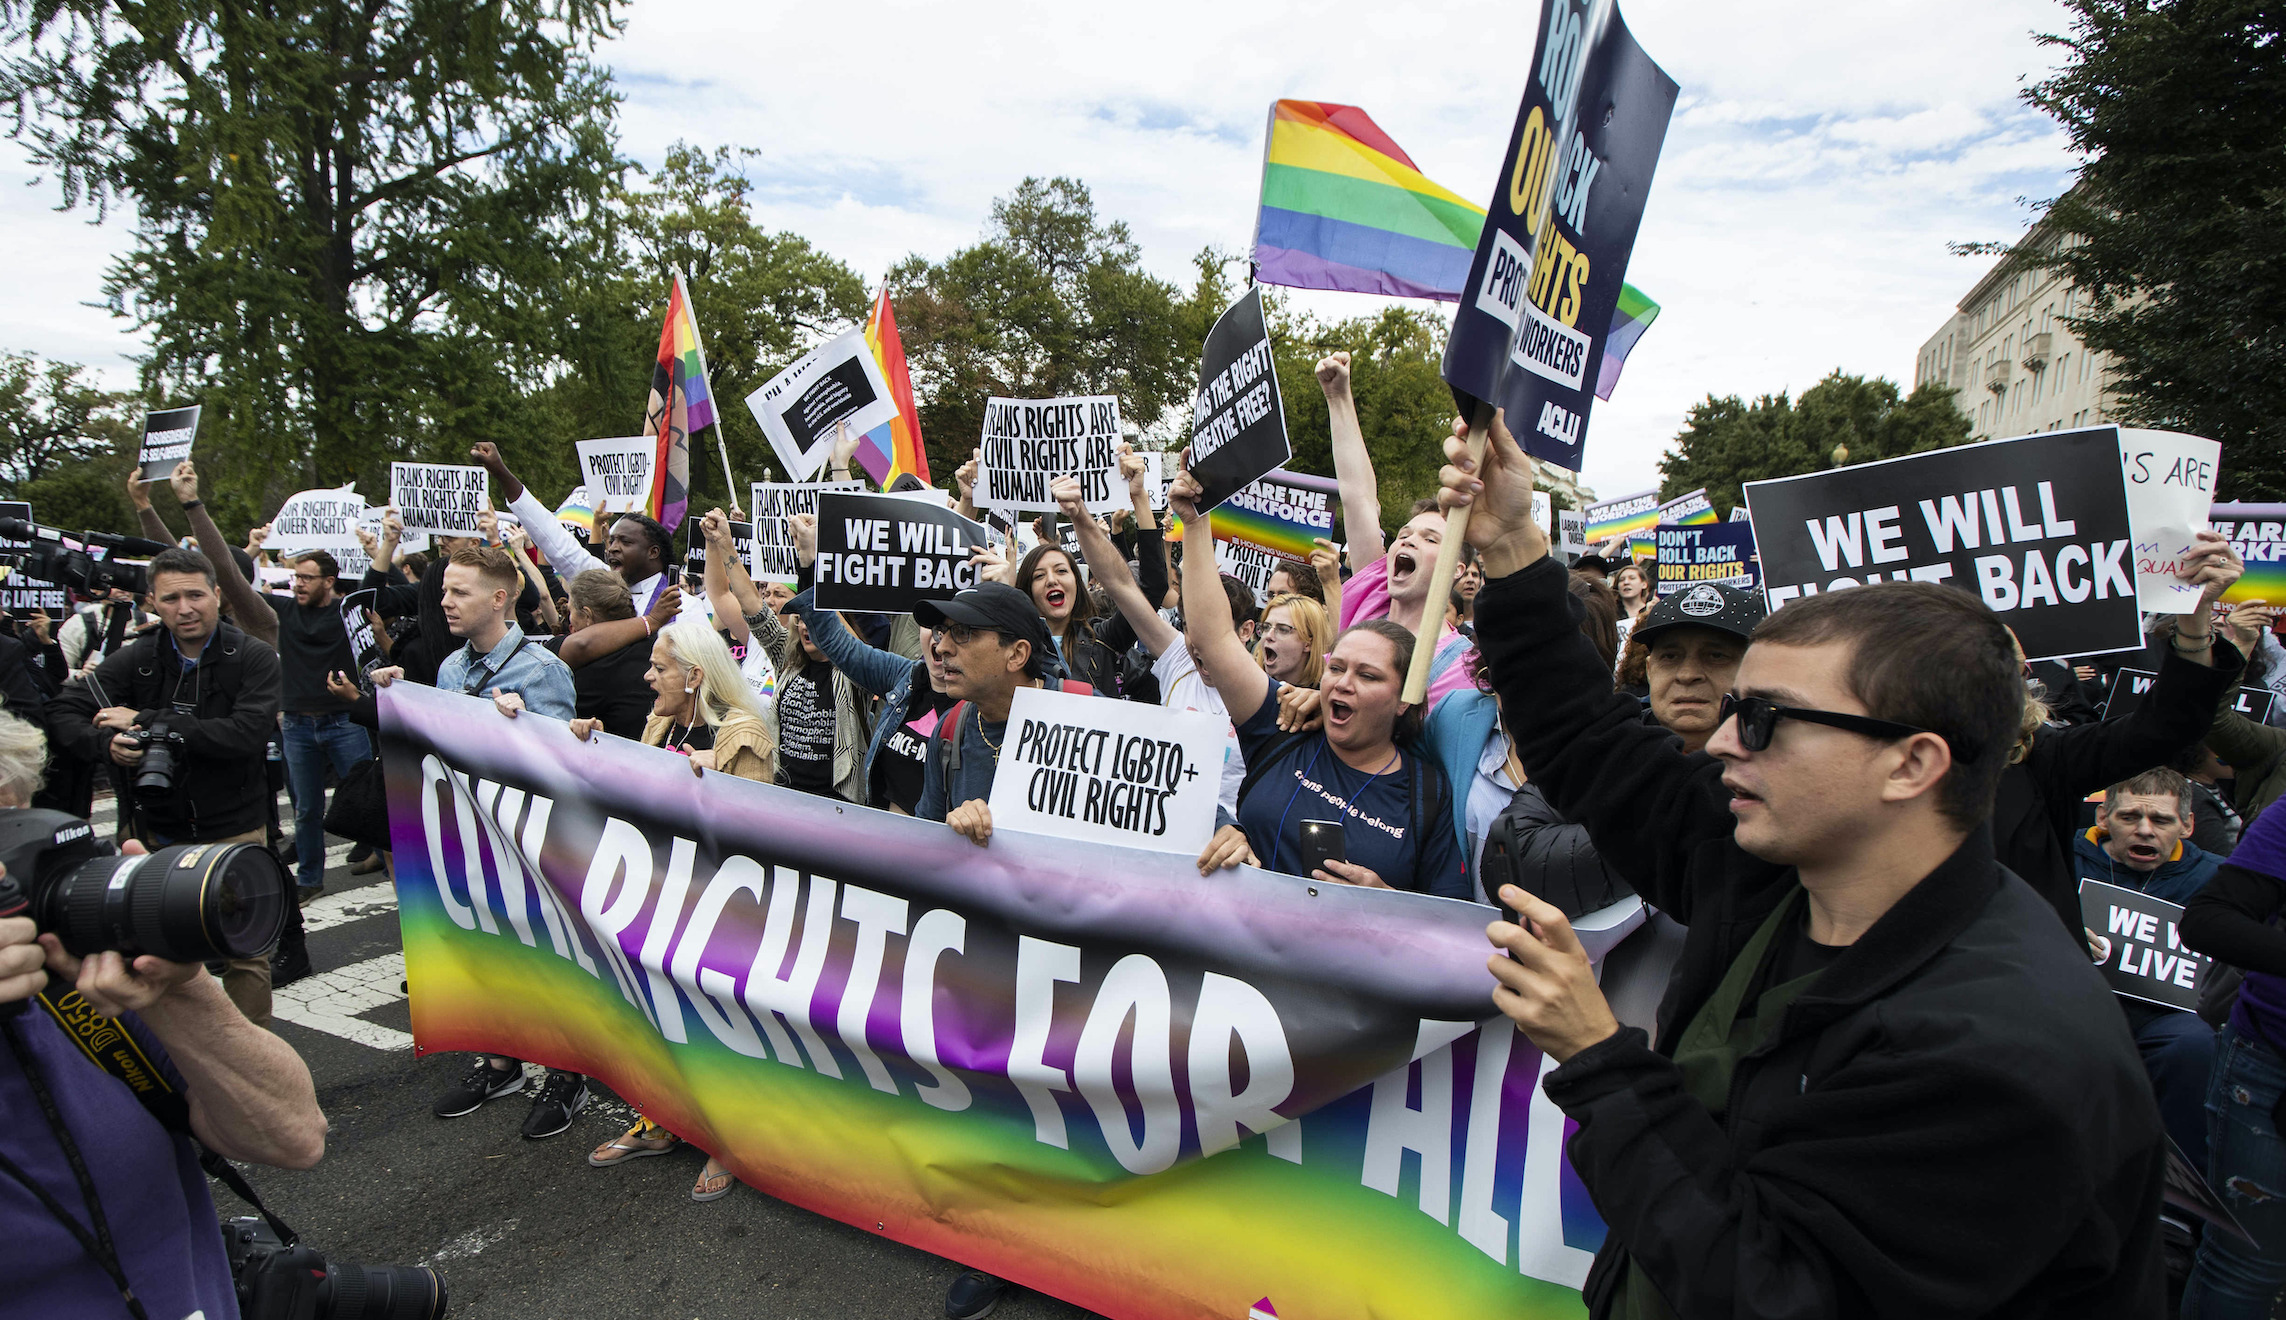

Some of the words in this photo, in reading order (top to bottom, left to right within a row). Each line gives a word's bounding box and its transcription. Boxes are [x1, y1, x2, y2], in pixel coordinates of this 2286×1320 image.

[1510, 105, 1559, 238] OU
[1519, 313, 1584, 378] WORKERS
[1210, 369, 1233, 410] THE
[1230, 338, 1269, 394] RIGHT
[985, 403, 1021, 438] TRANS
[1025, 403, 1085, 438] RIGHTS
[1090, 402, 1118, 435] ARE
[1193, 406, 1239, 463] BREATHE
[1235, 380, 1273, 431] FREE?
[1536, 401, 1581, 446] ACLU
[589, 453, 625, 475] PROTECT
[984, 436, 1016, 470] CIVIL
[1019, 438, 1079, 471] RIGHTS
[1084, 435, 1115, 469] ARE
[395, 467, 423, 488] TRANS
[426, 469, 460, 490] RIGHTS
[464, 471, 484, 491] ARE
[604, 475, 621, 496] CIVIL
[622, 474, 645, 495] RIGHTS
[989, 469, 1046, 502] HUMAN
[2164, 457, 2211, 491] ARE
[302, 502, 337, 517] RIGHTS
[341, 503, 360, 519] ARE
[398, 487, 419, 508] CIVIL
[422, 489, 457, 510] RIGHTS
[461, 491, 479, 512] ARE
[755, 489, 782, 518] TRANS
[783, 488, 822, 517] RIGHT
[1225, 493, 1333, 529] ORKFORCE
[1248, 482, 1287, 504] ARE
[1288, 487, 1328, 511] THE
[1608, 499, 1634, 511] ARE
[1633, 494, 1654, 505] THE
[277, 518, 308, 536] QUEER
[311, 518, 347, 535] RIGHTS
[402, 508, 440, 529] HUMAN
[441, 511, 477, 531] RIGHTS
[1561, 519, 1579, 533] LABOR
[1588, 500, 1658, 525] WORKFORCE
[1806, 505, 1909, 571] WE
[1918, 480, 2076, 554] WILL
[757, 517, 780, 546] CIVIL
[845, 518, 890, 552] WE
[898, 521, 969, 556] WILL
[1658, 530, 1703, 547] DON'T
[2237, 522, 2286, 541] AR
[1240, 540, 1275, 556] HOUSING
[1275, 548, 1305, 563] WORKS
[1658, 547, 1692, 564] ROLL
[1695, 545, 1737, 563] BACK
[816, 552, 906, 588] FIGHT
[1234, 562, 1260, 590] CIVIL
[1658, 564, 1685, 580] OUR
[1688, 561, 1745, 580] RIGHTS
[1974, 538, 2135, 612] BACK
[13, 590, 39, 608] LIVE
[40, 590, 64, 608] FREE
[1015, 719, 1110, 776] PROTECT
[1111, 733, 1199, 796] LGBTQ+
[1028, 767, 1079, 819] CIVIL
[1083, 777, 1171, 836] RIGHTS
[1294, 769, 1323, 793] trans
[1320, 790, 1359, 818] people
[1360, 811, 1405, 839] belong
[55, 824, 90, 845] Nikon
[2108, 904, 2159, 944] WE
[2118, 942, 2198, 990] LIVE
[421, 753, 600, 980] CIVIL
[580, 817, 973, 1112] RIGHTS
[1007, 934, 1303, 1176] FOR
[1360, 1018, 1597, 1290] ALL
[113, 1049, 153, 1093] Nikon
